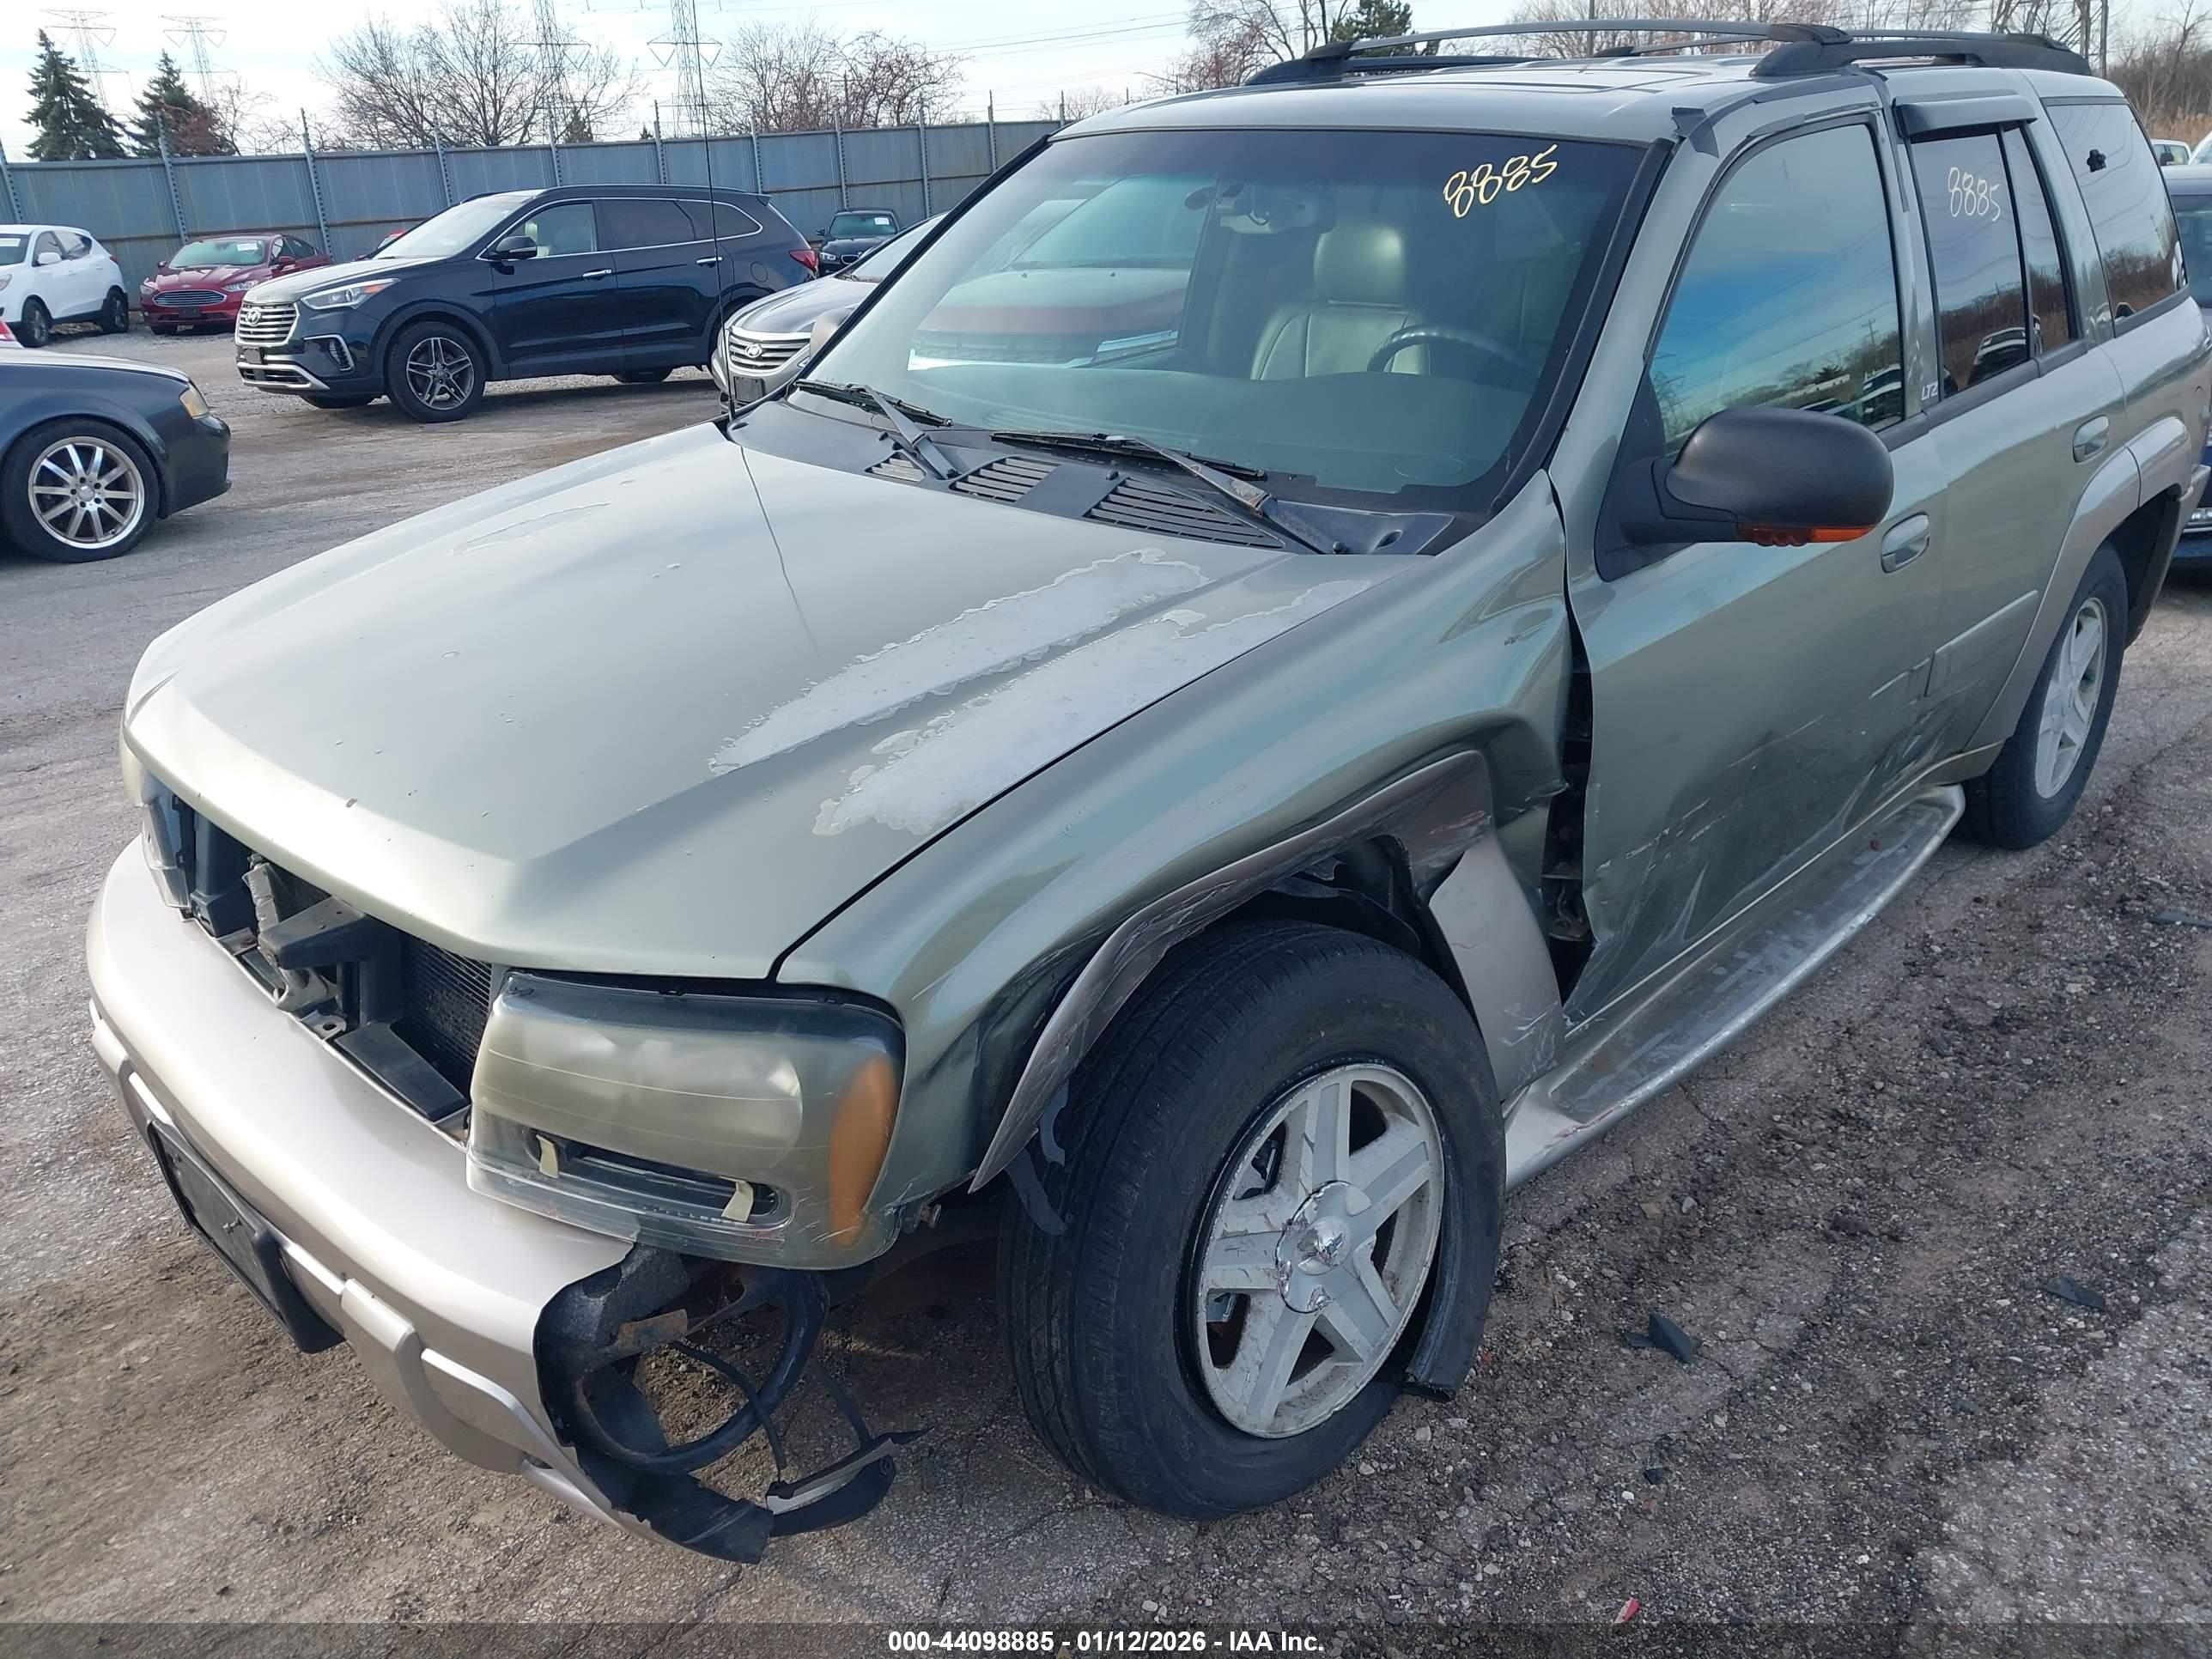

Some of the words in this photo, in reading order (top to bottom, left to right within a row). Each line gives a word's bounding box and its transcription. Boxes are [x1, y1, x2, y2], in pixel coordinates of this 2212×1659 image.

[1443, 143, 1559, 219] 8885
[1948, 166, 2002, 222] 8885
[1921, 380, 1939, 401] LTZ
